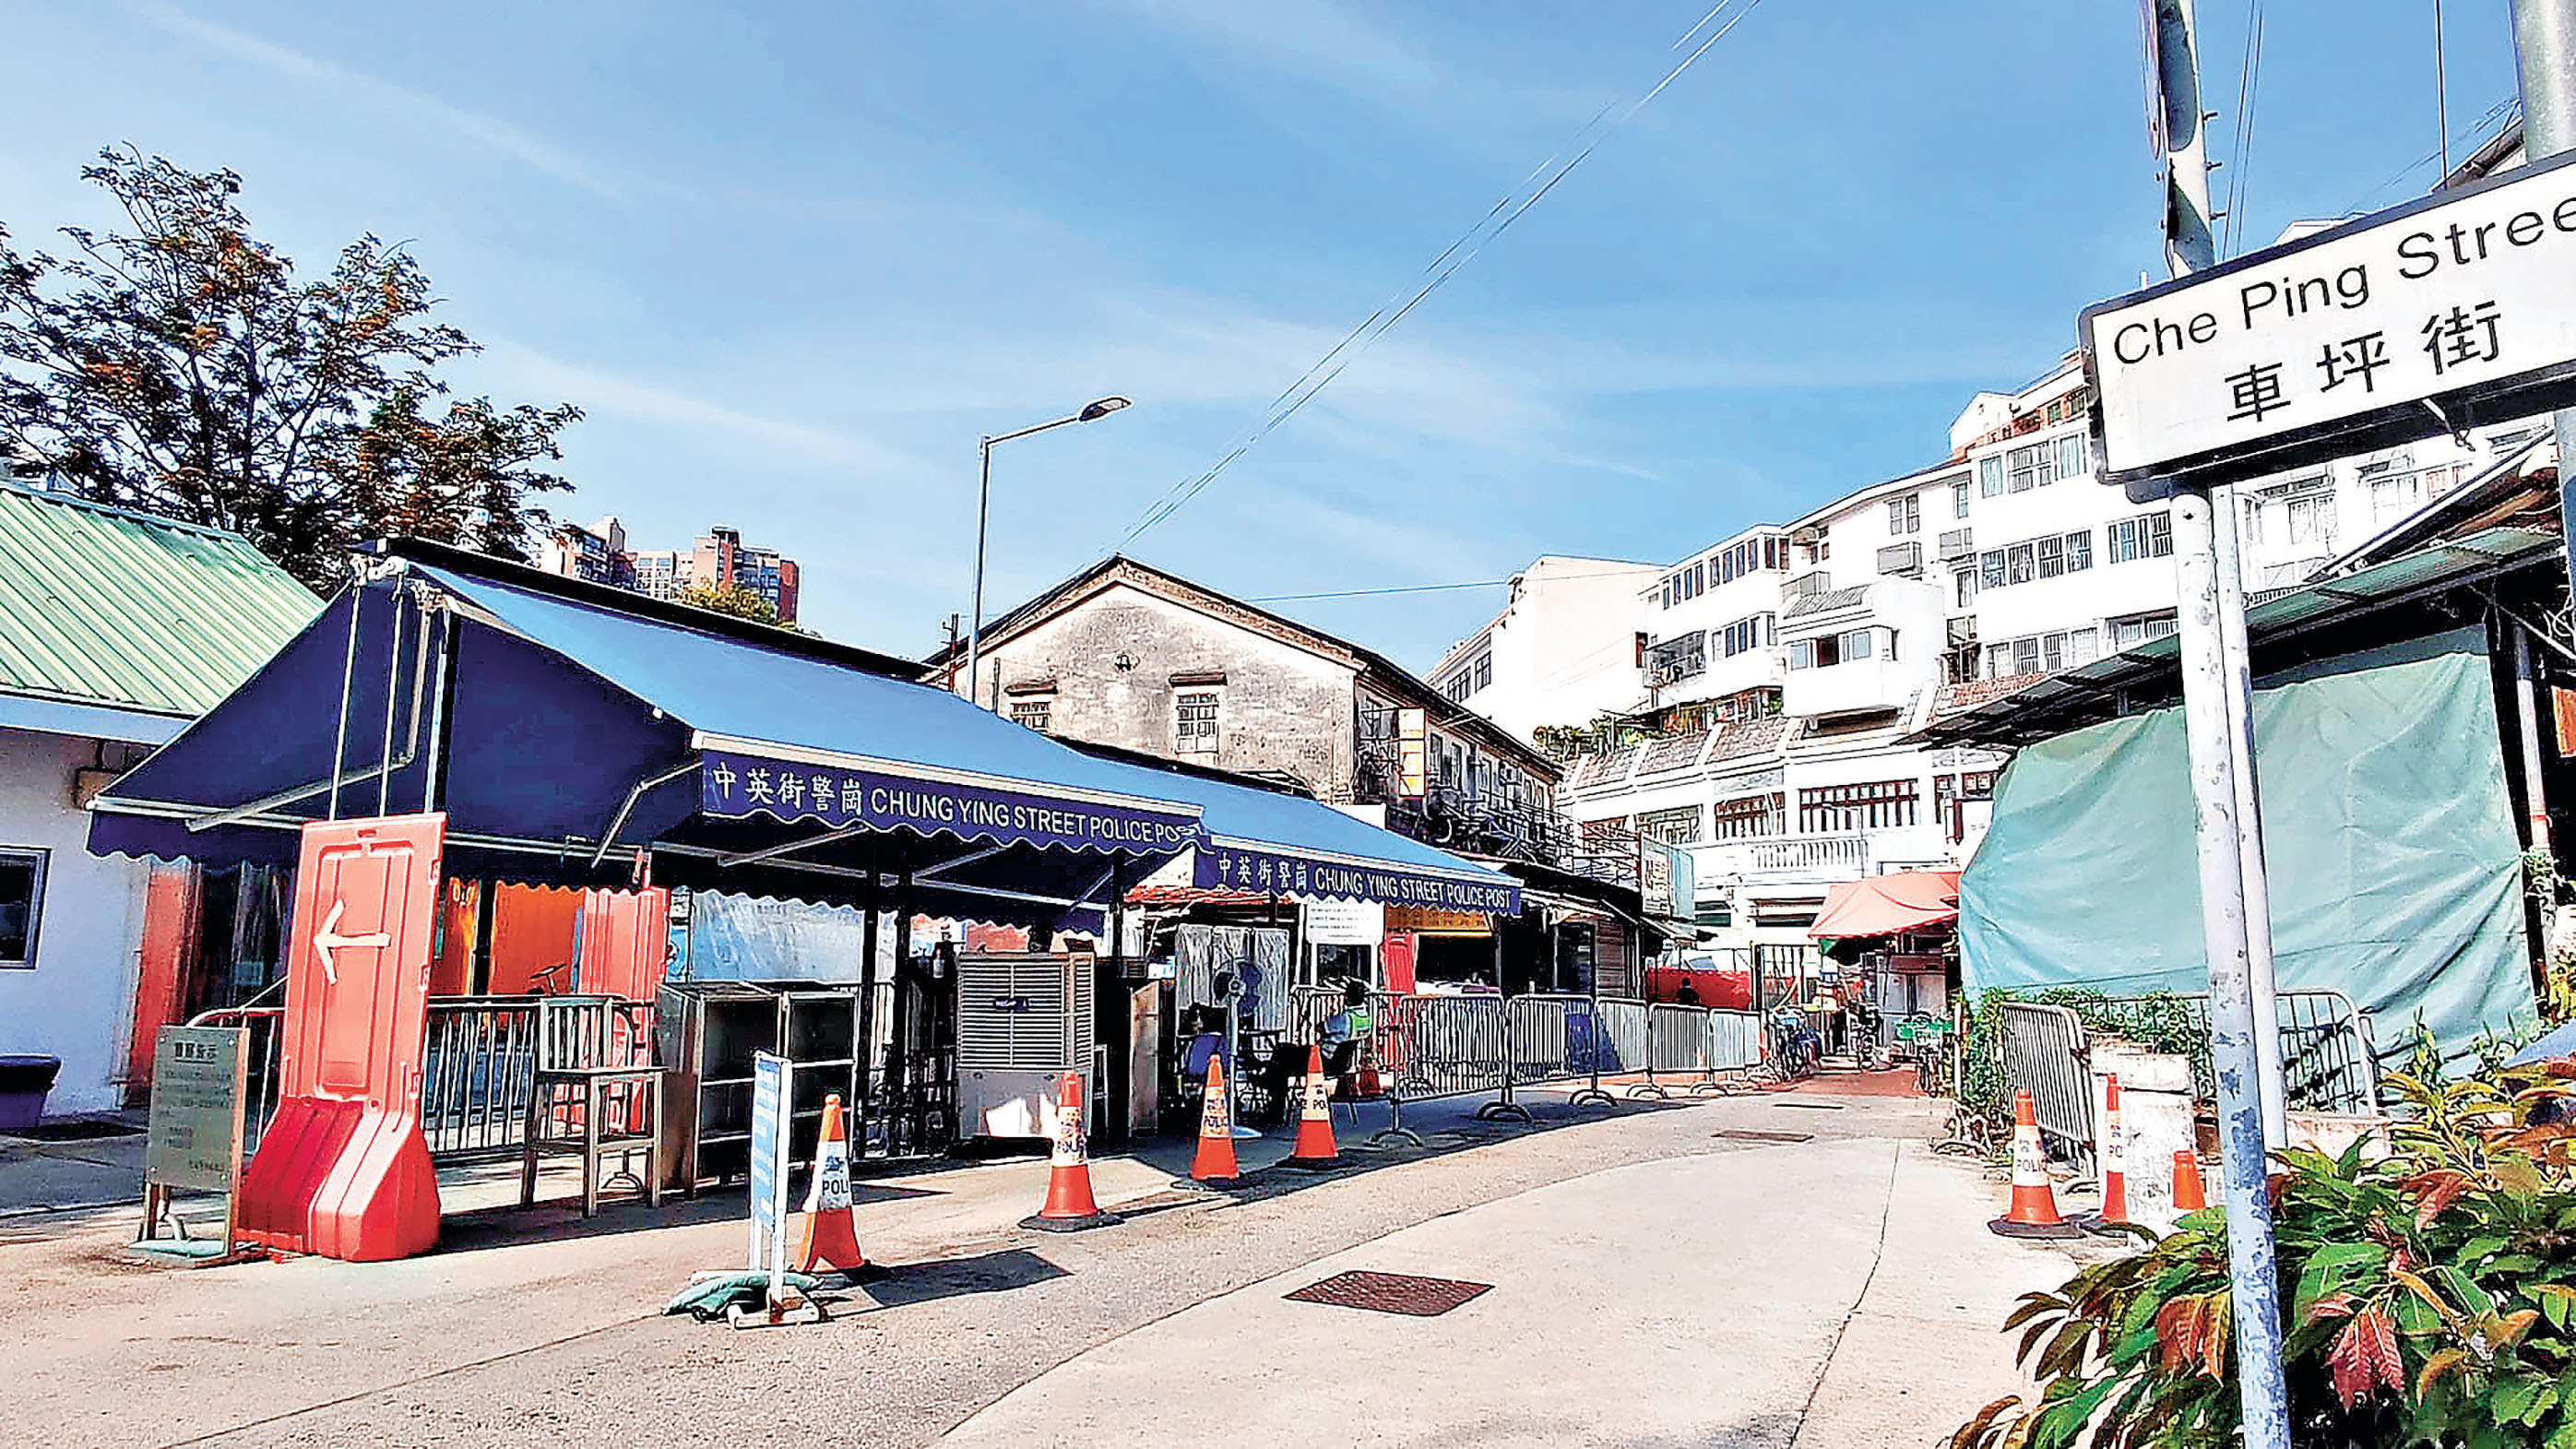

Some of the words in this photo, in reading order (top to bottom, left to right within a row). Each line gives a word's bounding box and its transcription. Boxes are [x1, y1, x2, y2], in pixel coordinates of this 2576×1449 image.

[2114, 313, 2217, 363] Che
[2242, 265, 2368, 329] Ping
[2225, 300, 2500, 422] 車坪街
[713, 761, 862, 815] 中英街警崗
[872, 788, 954, 822] CHUNG
[957, 799, 1009, 827] YING
[1015, 806, 1086, 837] STREET
[1090, 816, 1154, 843] POLICE
[1314, 867, 1363, 897] CHUNG
[1366, 873, 1398, 897] YING
[1401, 879, 1444, 903] STREET
[1446, 885, 1484, 907] POLICE
[1485, 888, 1511, 909] POST
